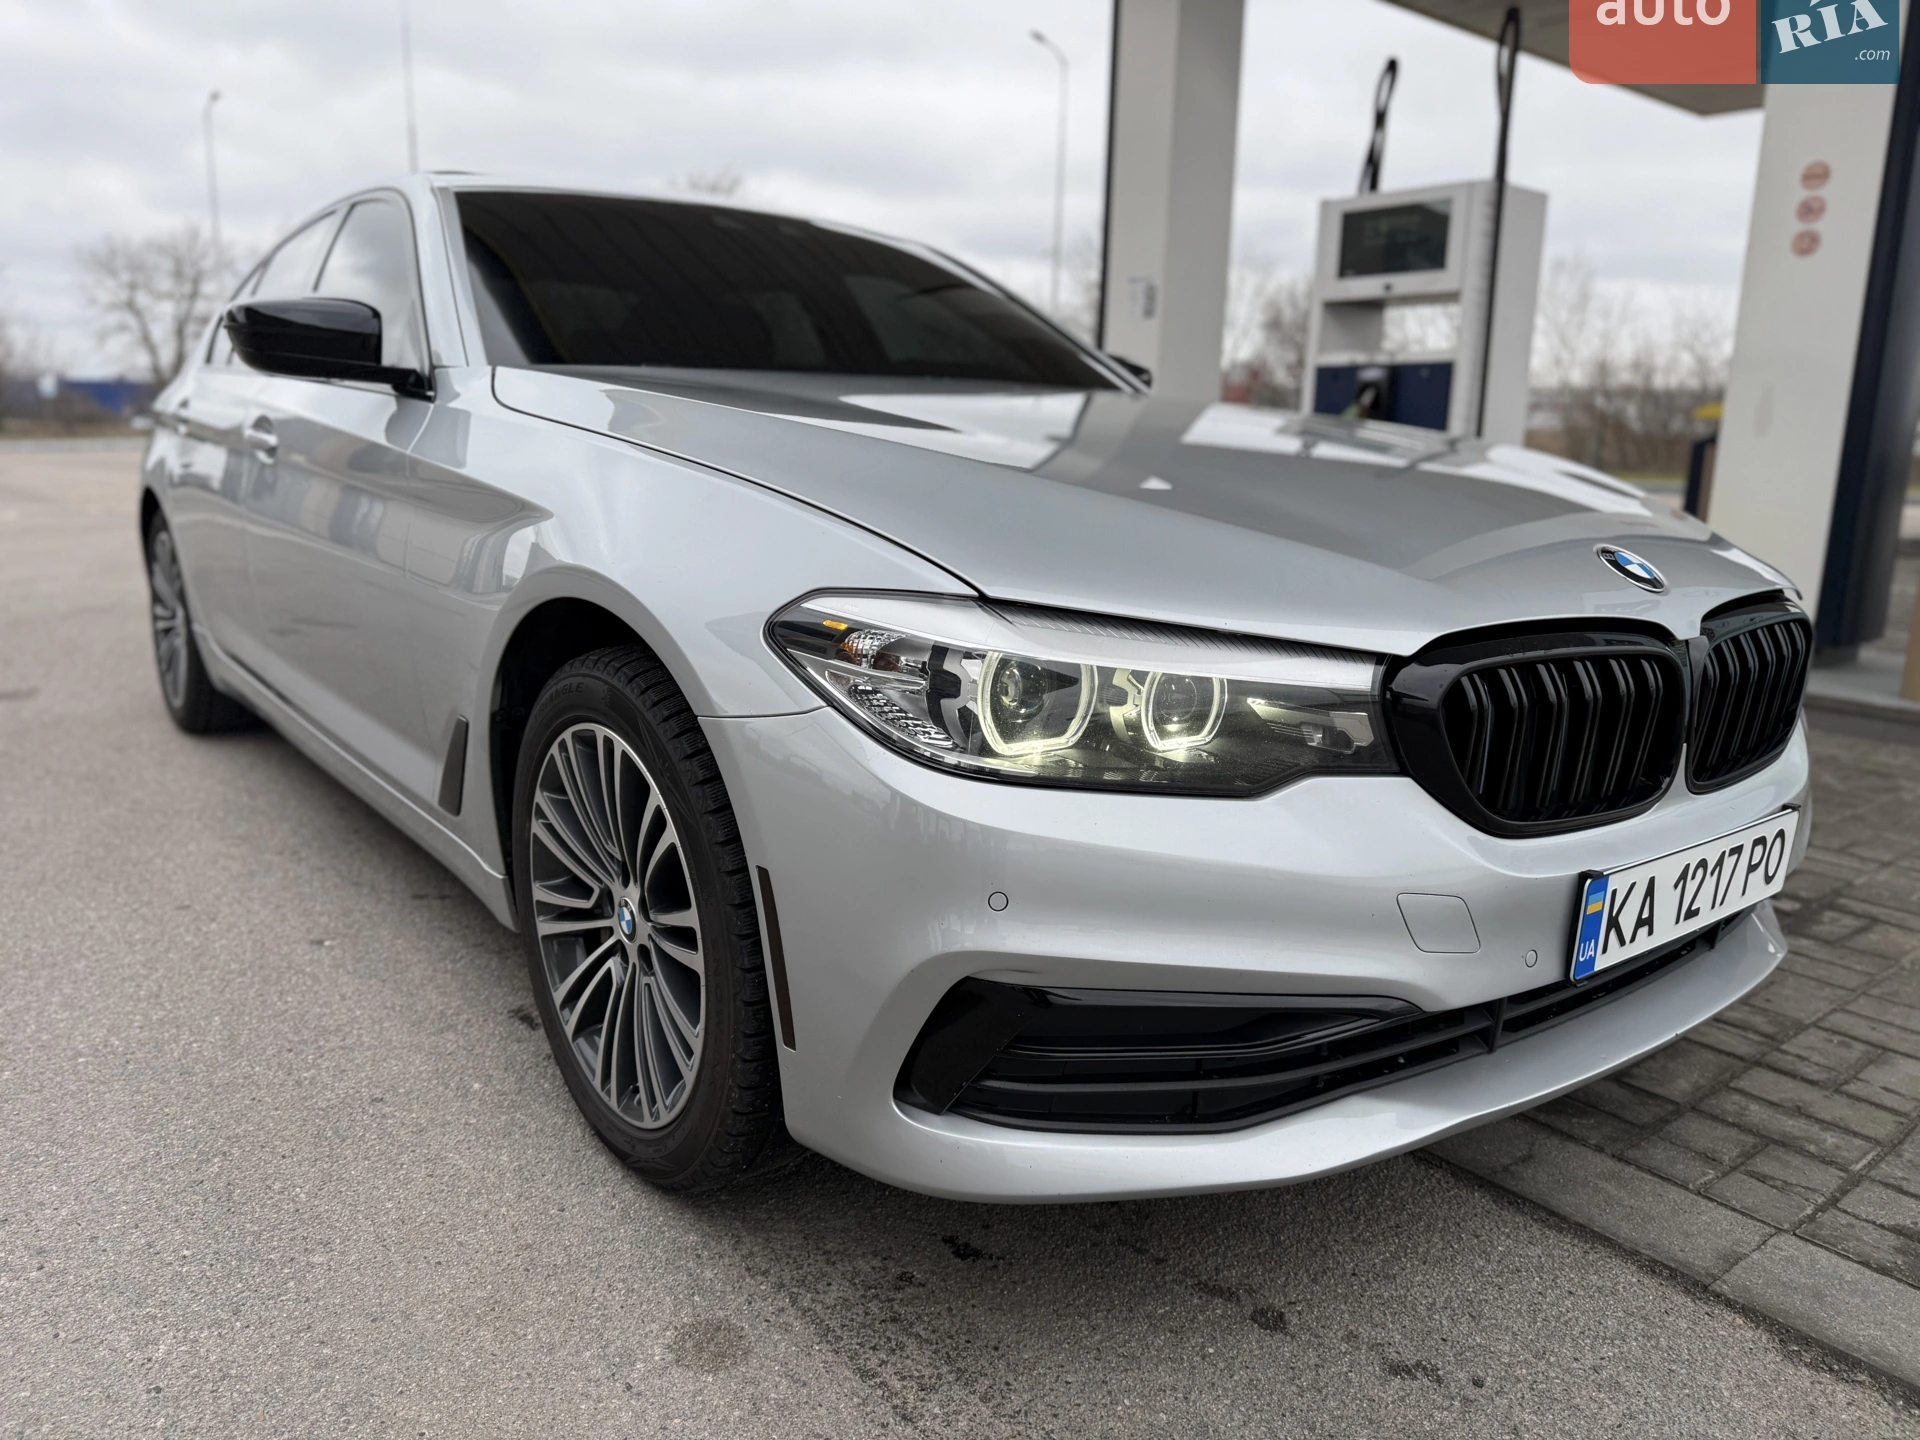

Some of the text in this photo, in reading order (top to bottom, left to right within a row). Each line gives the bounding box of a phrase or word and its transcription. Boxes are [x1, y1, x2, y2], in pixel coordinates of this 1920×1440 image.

[1601, 828, 1786, 955] KA 1217 PO
[1578, 938, 1596, 962] UA
